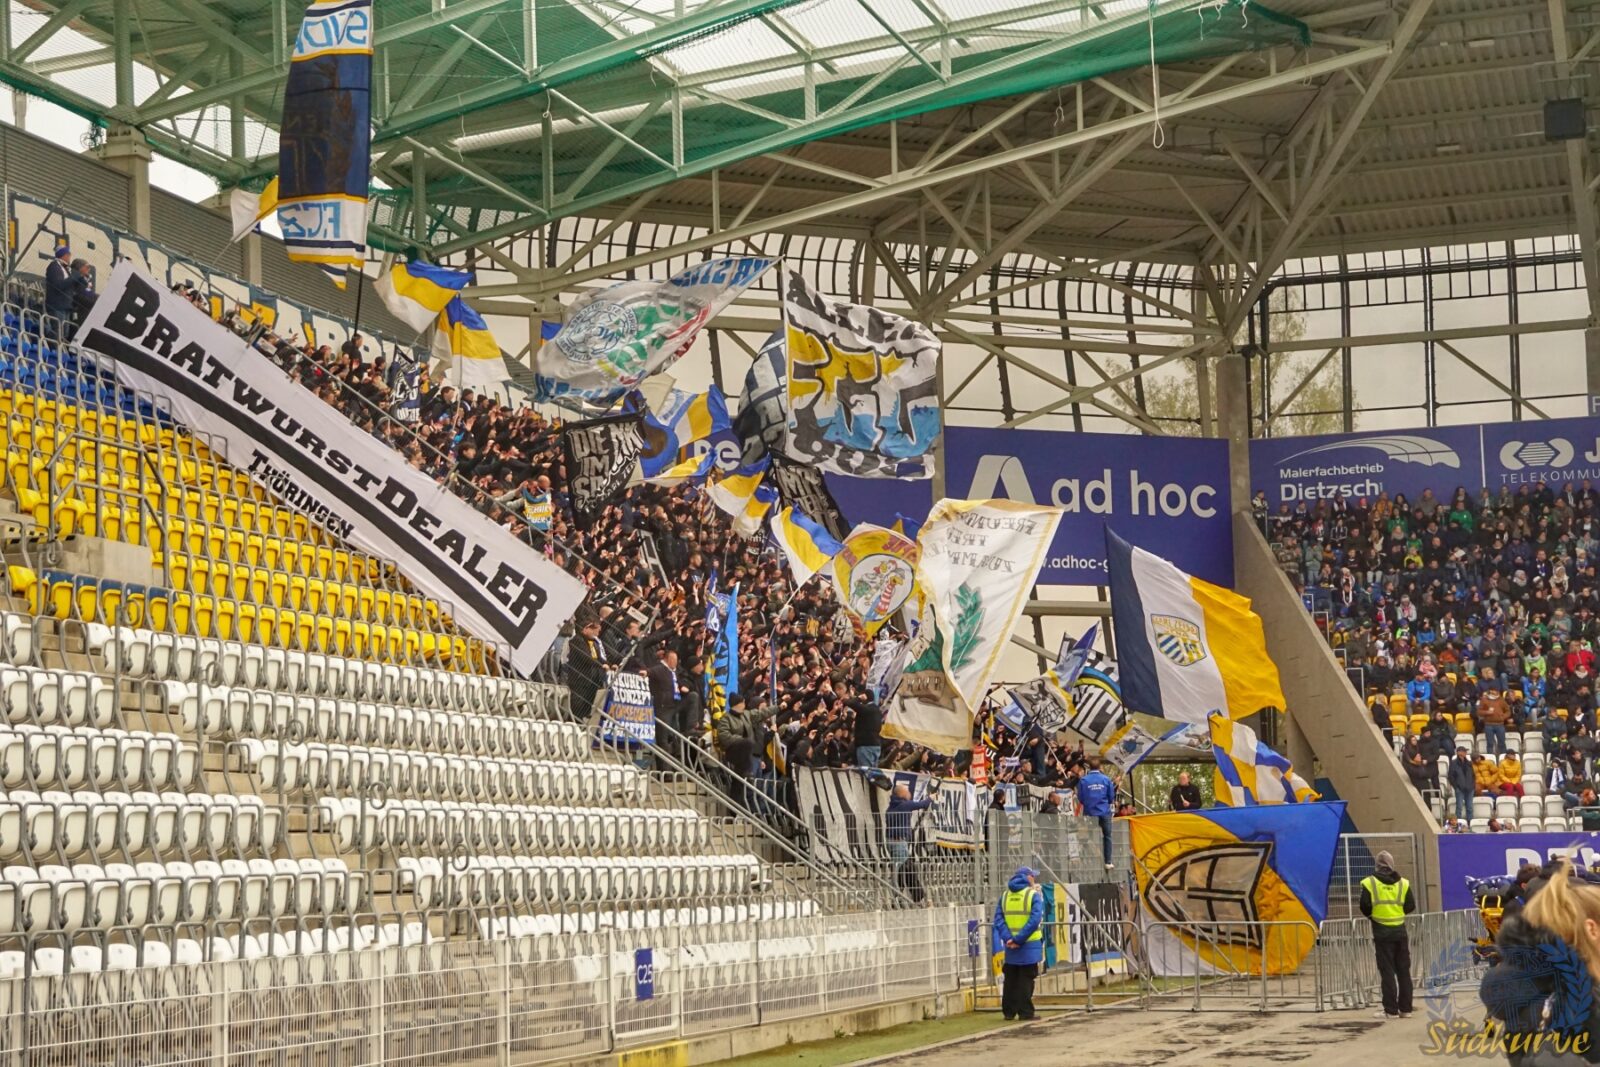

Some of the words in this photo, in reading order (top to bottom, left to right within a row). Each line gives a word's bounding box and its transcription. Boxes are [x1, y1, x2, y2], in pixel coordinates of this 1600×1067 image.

[1280, 463, 1384, 479] Malerfachbetrieb
[249, 450, 355, 539] THÜRINGEN
[1051, 469, 1113, 514] ad
[1130, 470, 1217, 518] hoc
[1281, 479, 1379, 501] Dietzsch
[637, 964, 652, 984] C25
